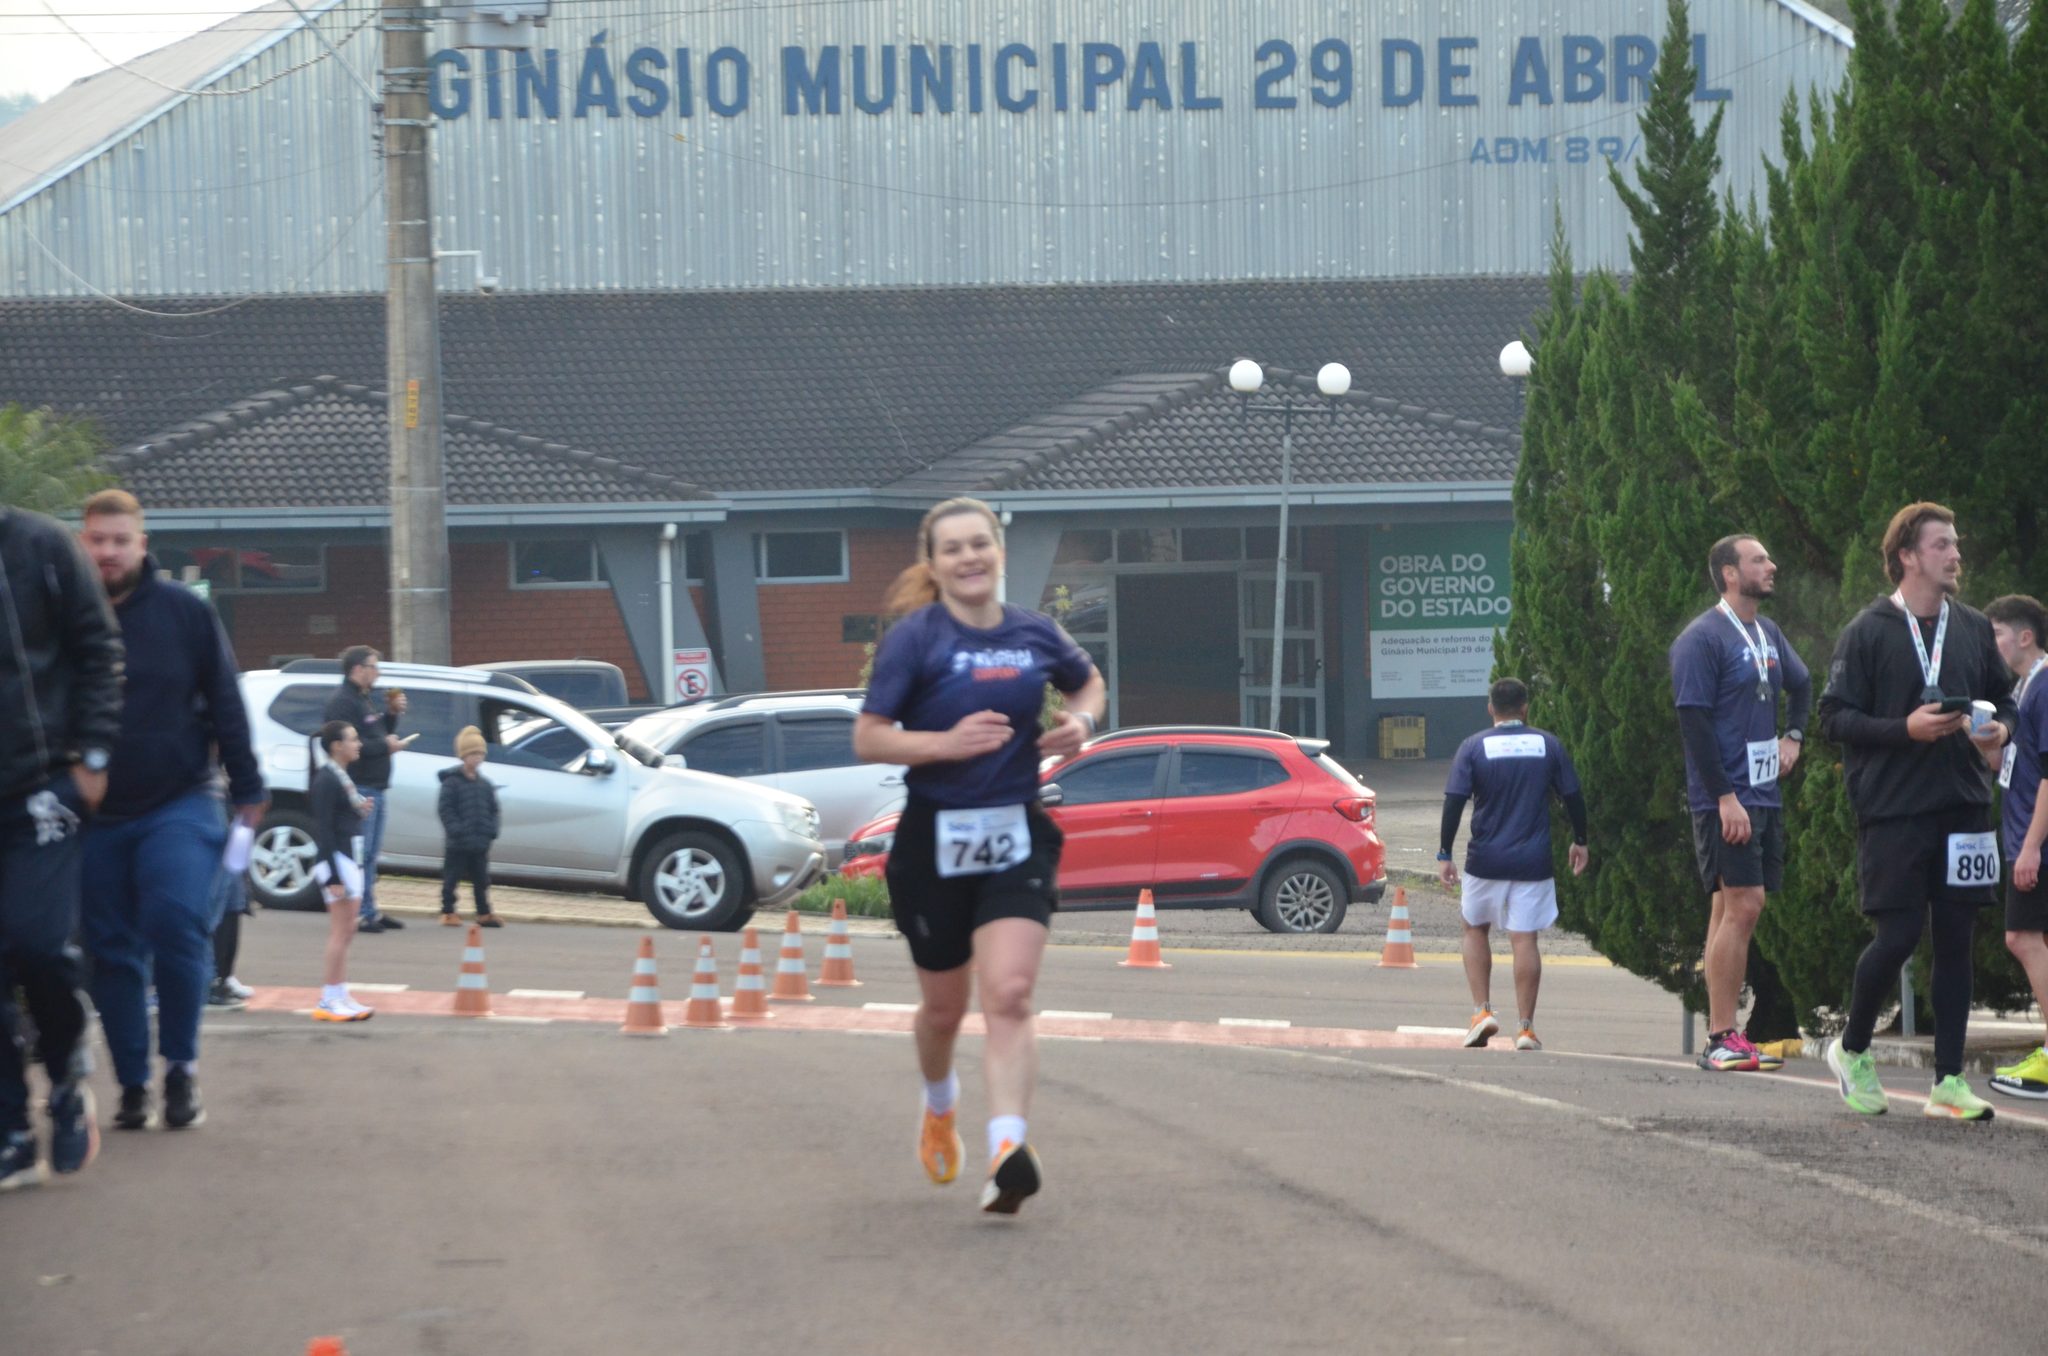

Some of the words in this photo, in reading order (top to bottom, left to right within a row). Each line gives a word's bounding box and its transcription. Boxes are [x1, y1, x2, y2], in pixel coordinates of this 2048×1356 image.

[428, 29, 750, 120] GINÁSIO
[781, 41, 1223, 116] MUNICIPAL
[1254, 39, 1353, 109] 29
[1380, 36, 1480, 107] DE
[1508, 33, 1733, 106] ABRL
[1565, 134, 1641, 163] 89/
[1380, 554, 1446, 574] OBRA
[1451, 553, 1487, 572] DO
[1380, 574, 1495, 596] GOVERNO
[1381, 599, 1416, 618] DO
[1421, 596, 1512, 617] ESTADO
[1381, 636, 1431, 646] Adequação
[1441, 635, 1476, 643] reforma
[1478, 634, 1491, 642] do
[1381, 647, 1414, 656] Ginásio
[1416, 646, 1459, 656] Municipal
[1461, 646, 1472, 654] 29
[1474, 645, 1486, 653] de
[950, 832, 1016, 869] 742
[1956, 853, 1997, 881] 890
